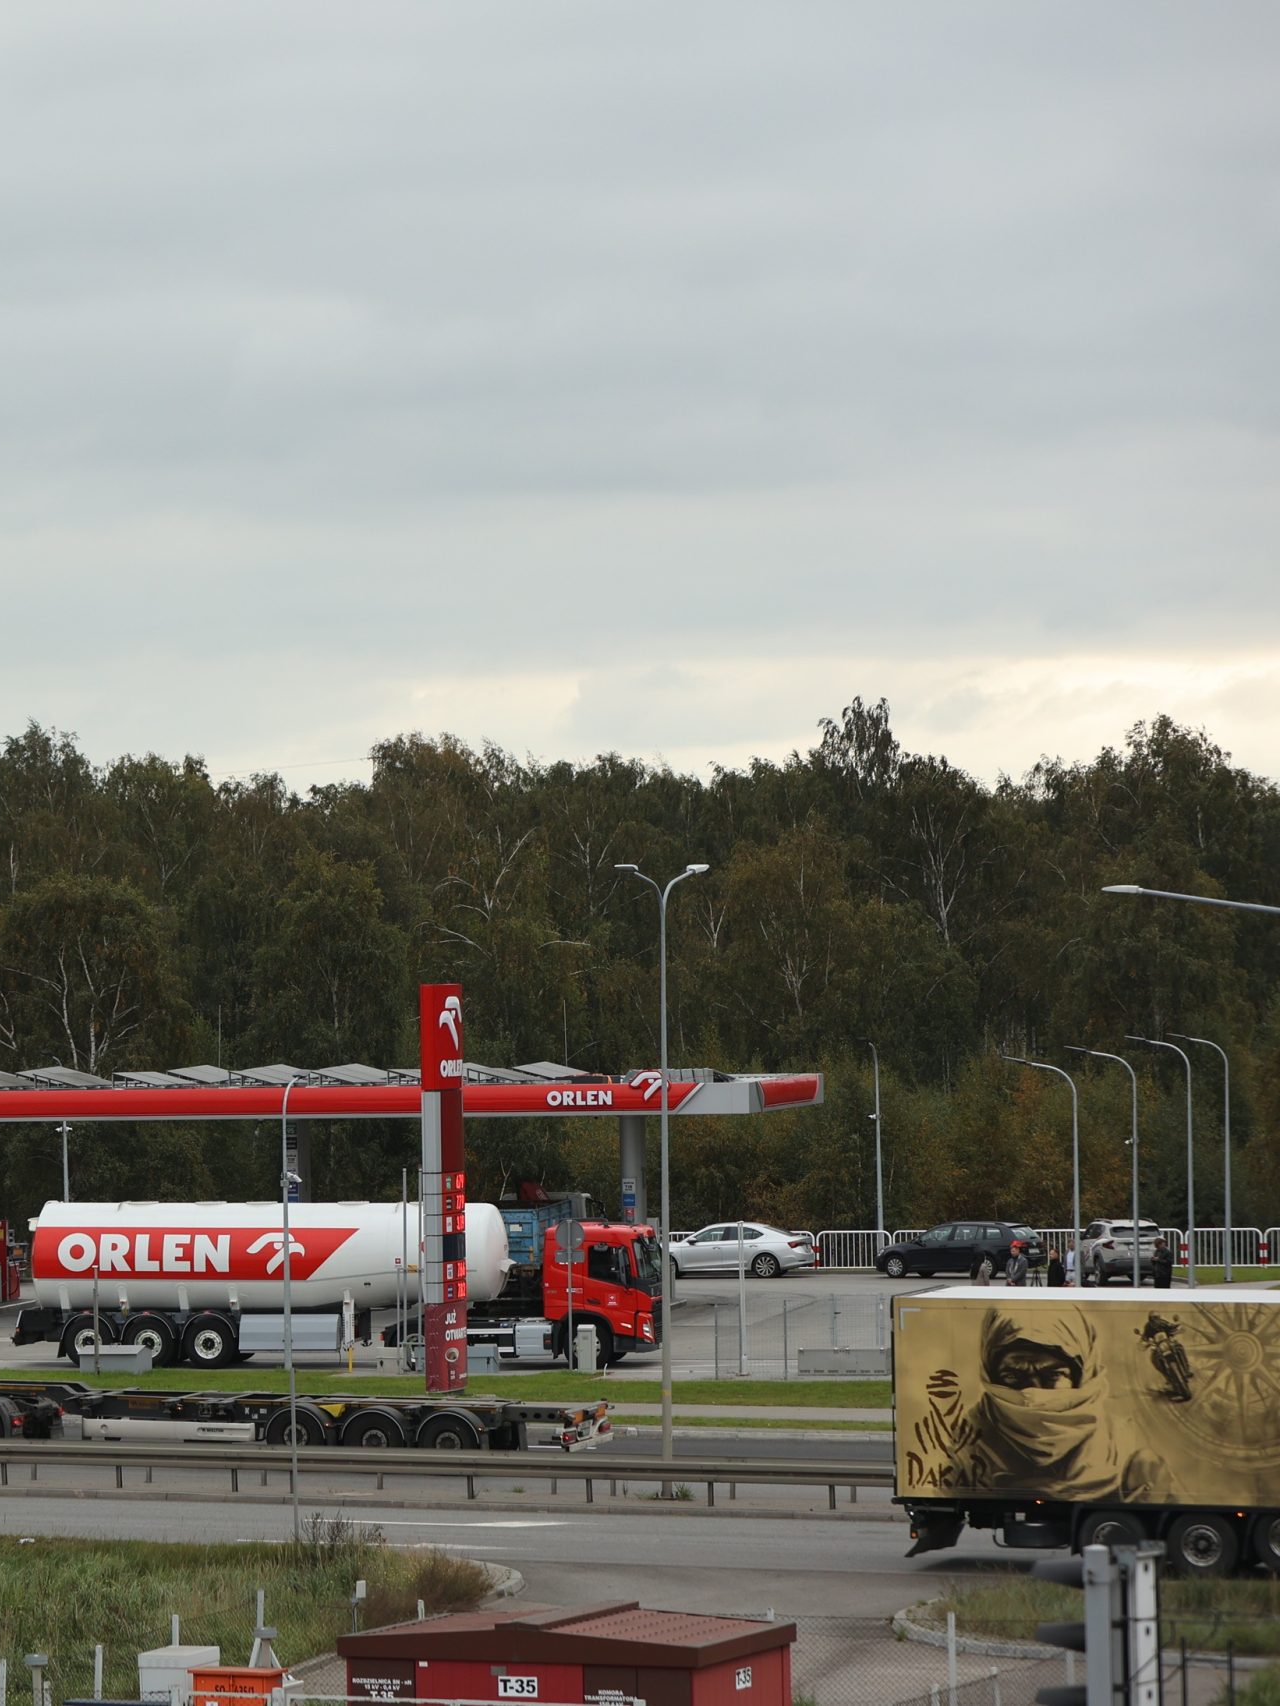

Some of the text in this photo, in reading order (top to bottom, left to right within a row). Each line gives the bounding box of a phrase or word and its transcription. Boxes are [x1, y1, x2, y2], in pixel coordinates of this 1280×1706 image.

[547, 1090, 613, 1106] ORLEN
[57, 1233, 231, 1272] ORLEN
[906, 1451, 993, 1493] DAKAR
[736, 1668, 751, 1686] T-35
[499, 1679, 536, 1694] T-35
